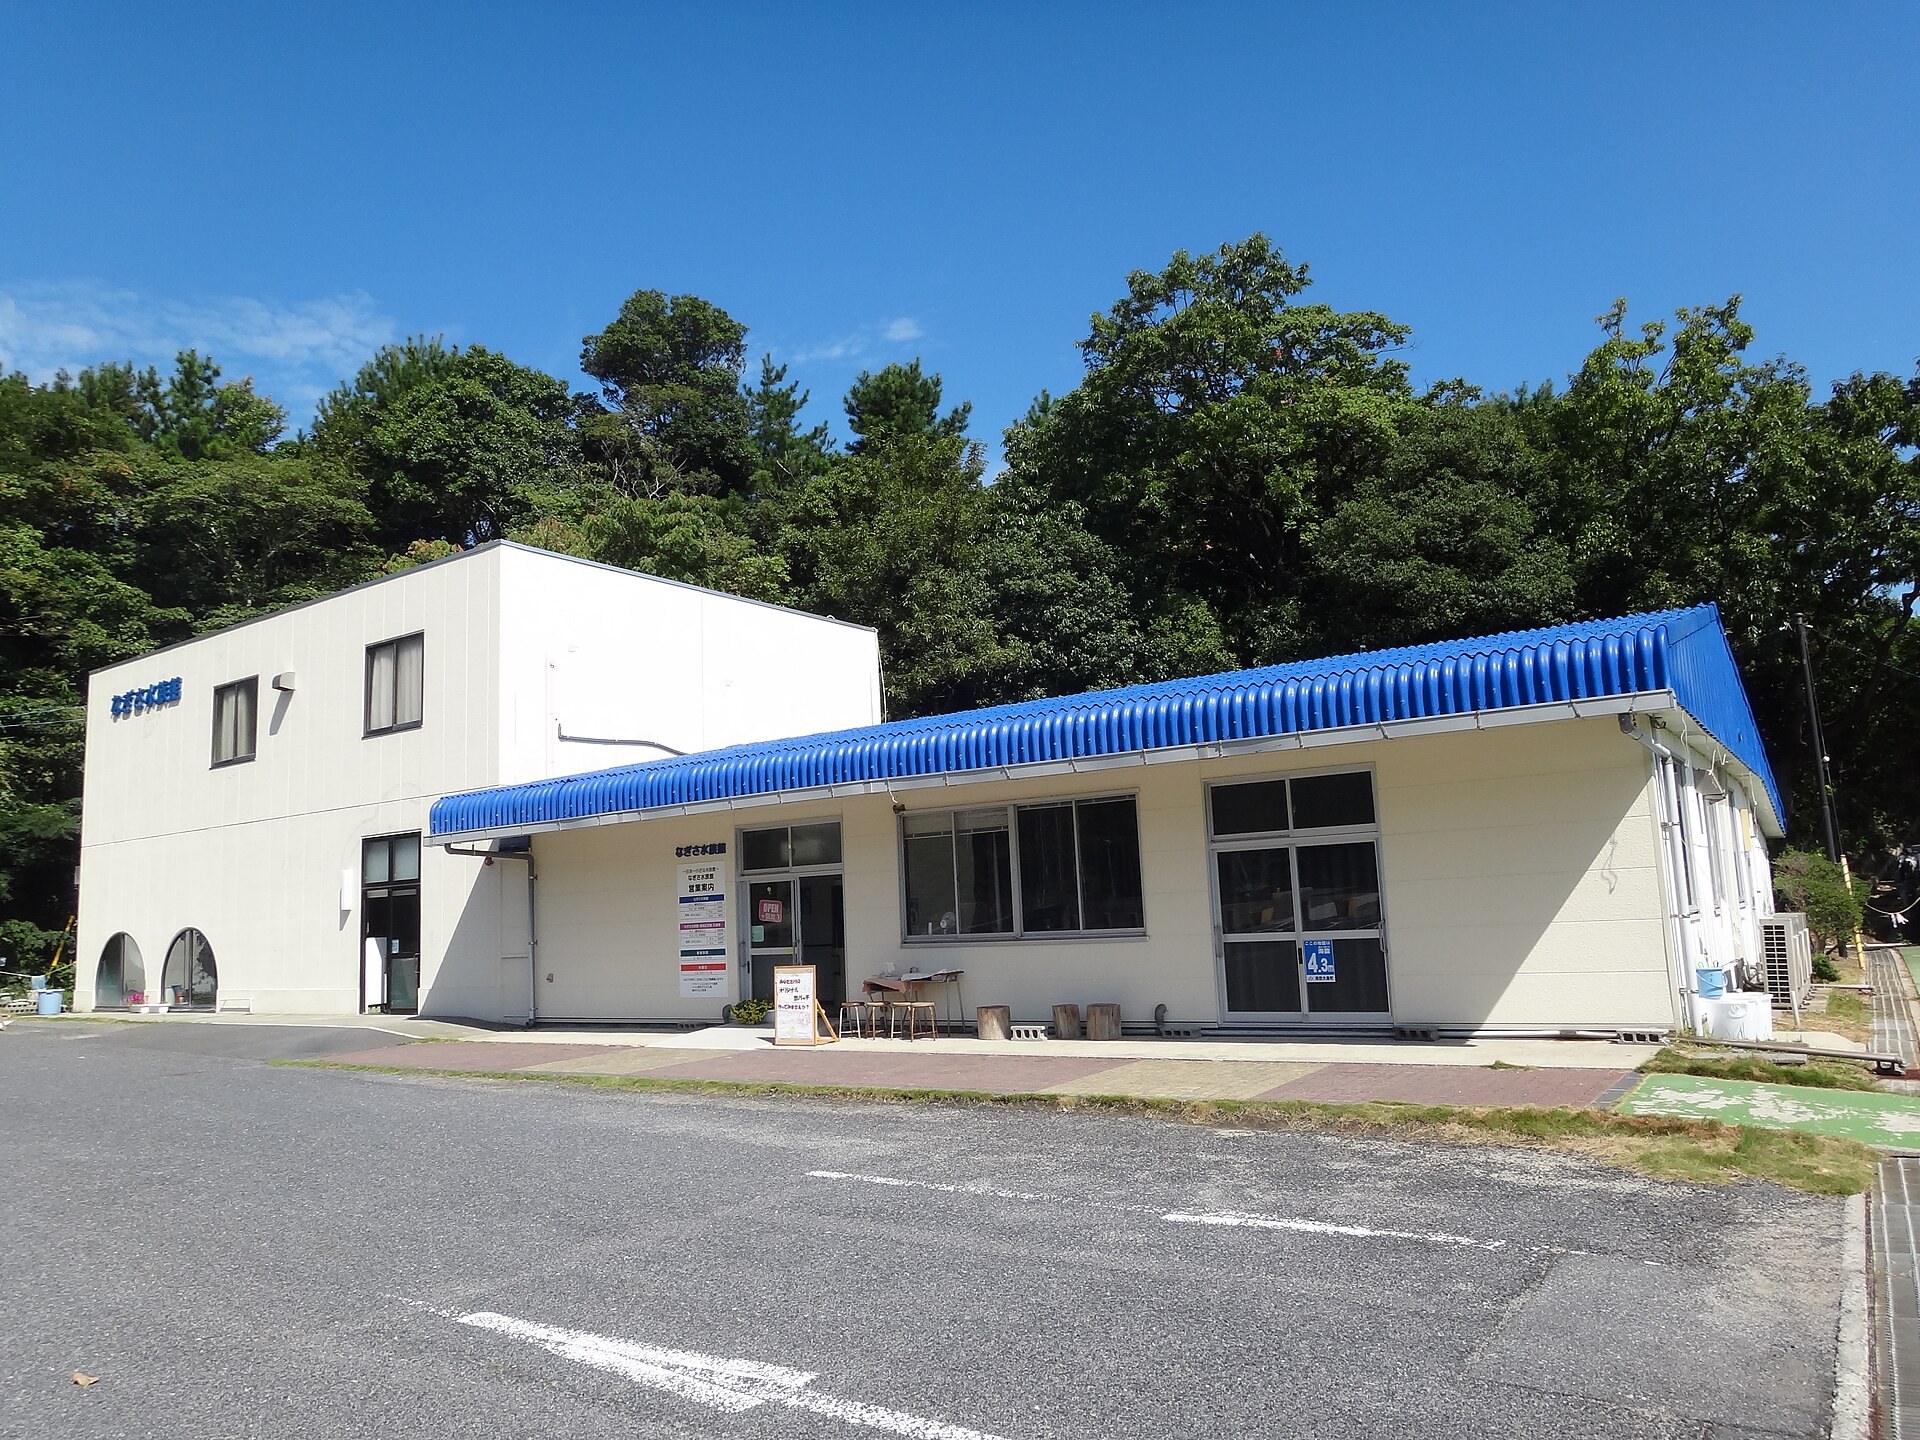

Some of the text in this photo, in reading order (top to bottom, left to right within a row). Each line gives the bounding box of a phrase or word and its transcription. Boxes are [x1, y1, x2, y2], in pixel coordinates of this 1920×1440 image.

[110, 676, 183, 717] なぎさ水族館
[675, 843, 727, 858] なぎさ水族館
[688, 873, 714, 881] なぎさ水族館
[688, 883, 715, 893] 営業案内
